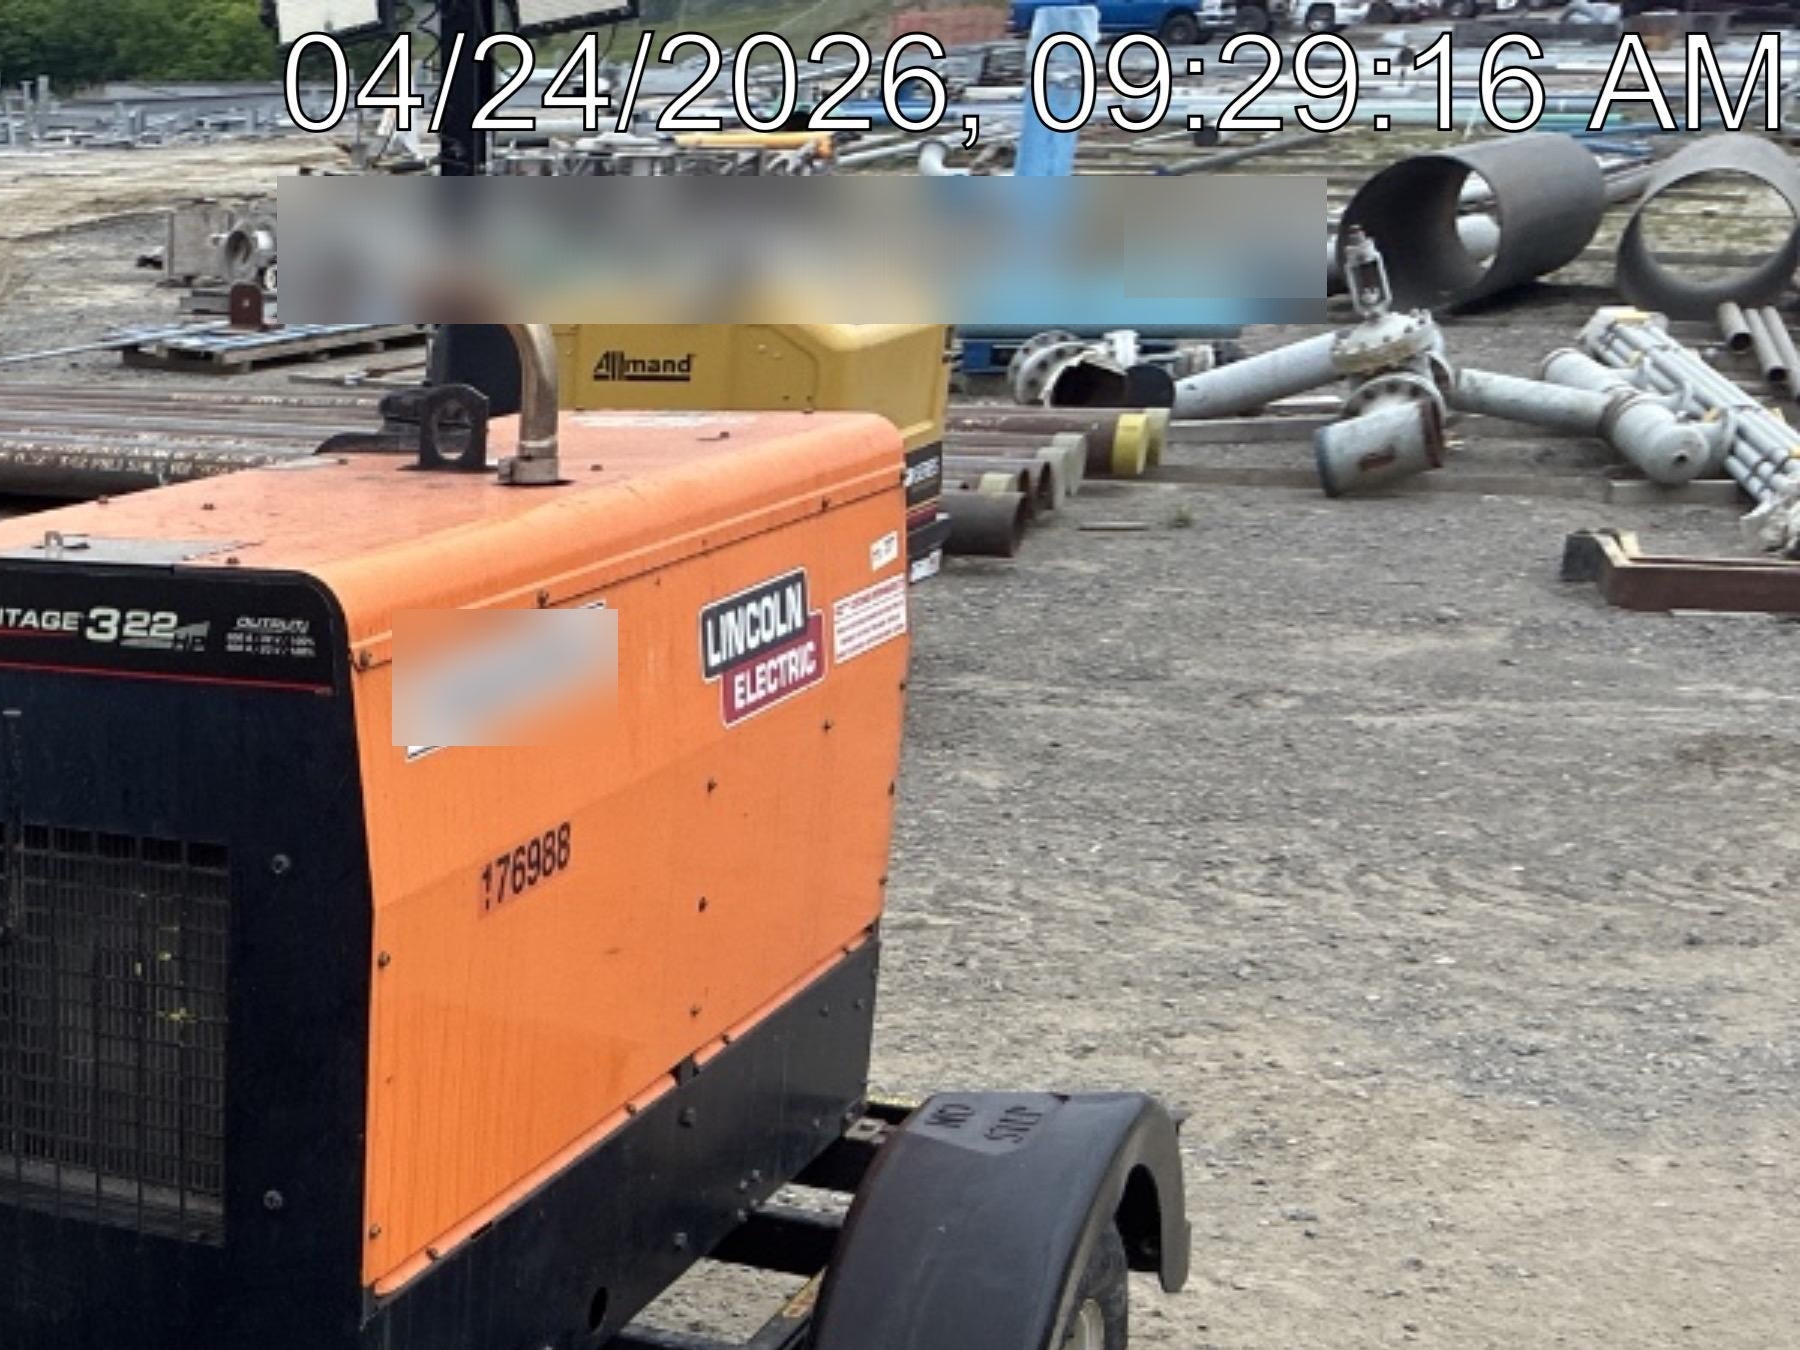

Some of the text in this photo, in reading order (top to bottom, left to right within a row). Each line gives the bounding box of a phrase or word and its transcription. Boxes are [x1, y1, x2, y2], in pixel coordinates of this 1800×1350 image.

[593, 351, 691, 381] Allmand
[85, 606, 179, 642] 322
[706, 582, 804, 668] LINCOLN
[733, 641, 817, 711] ELECTRIC
[481, 822, 571, 911] 176988
